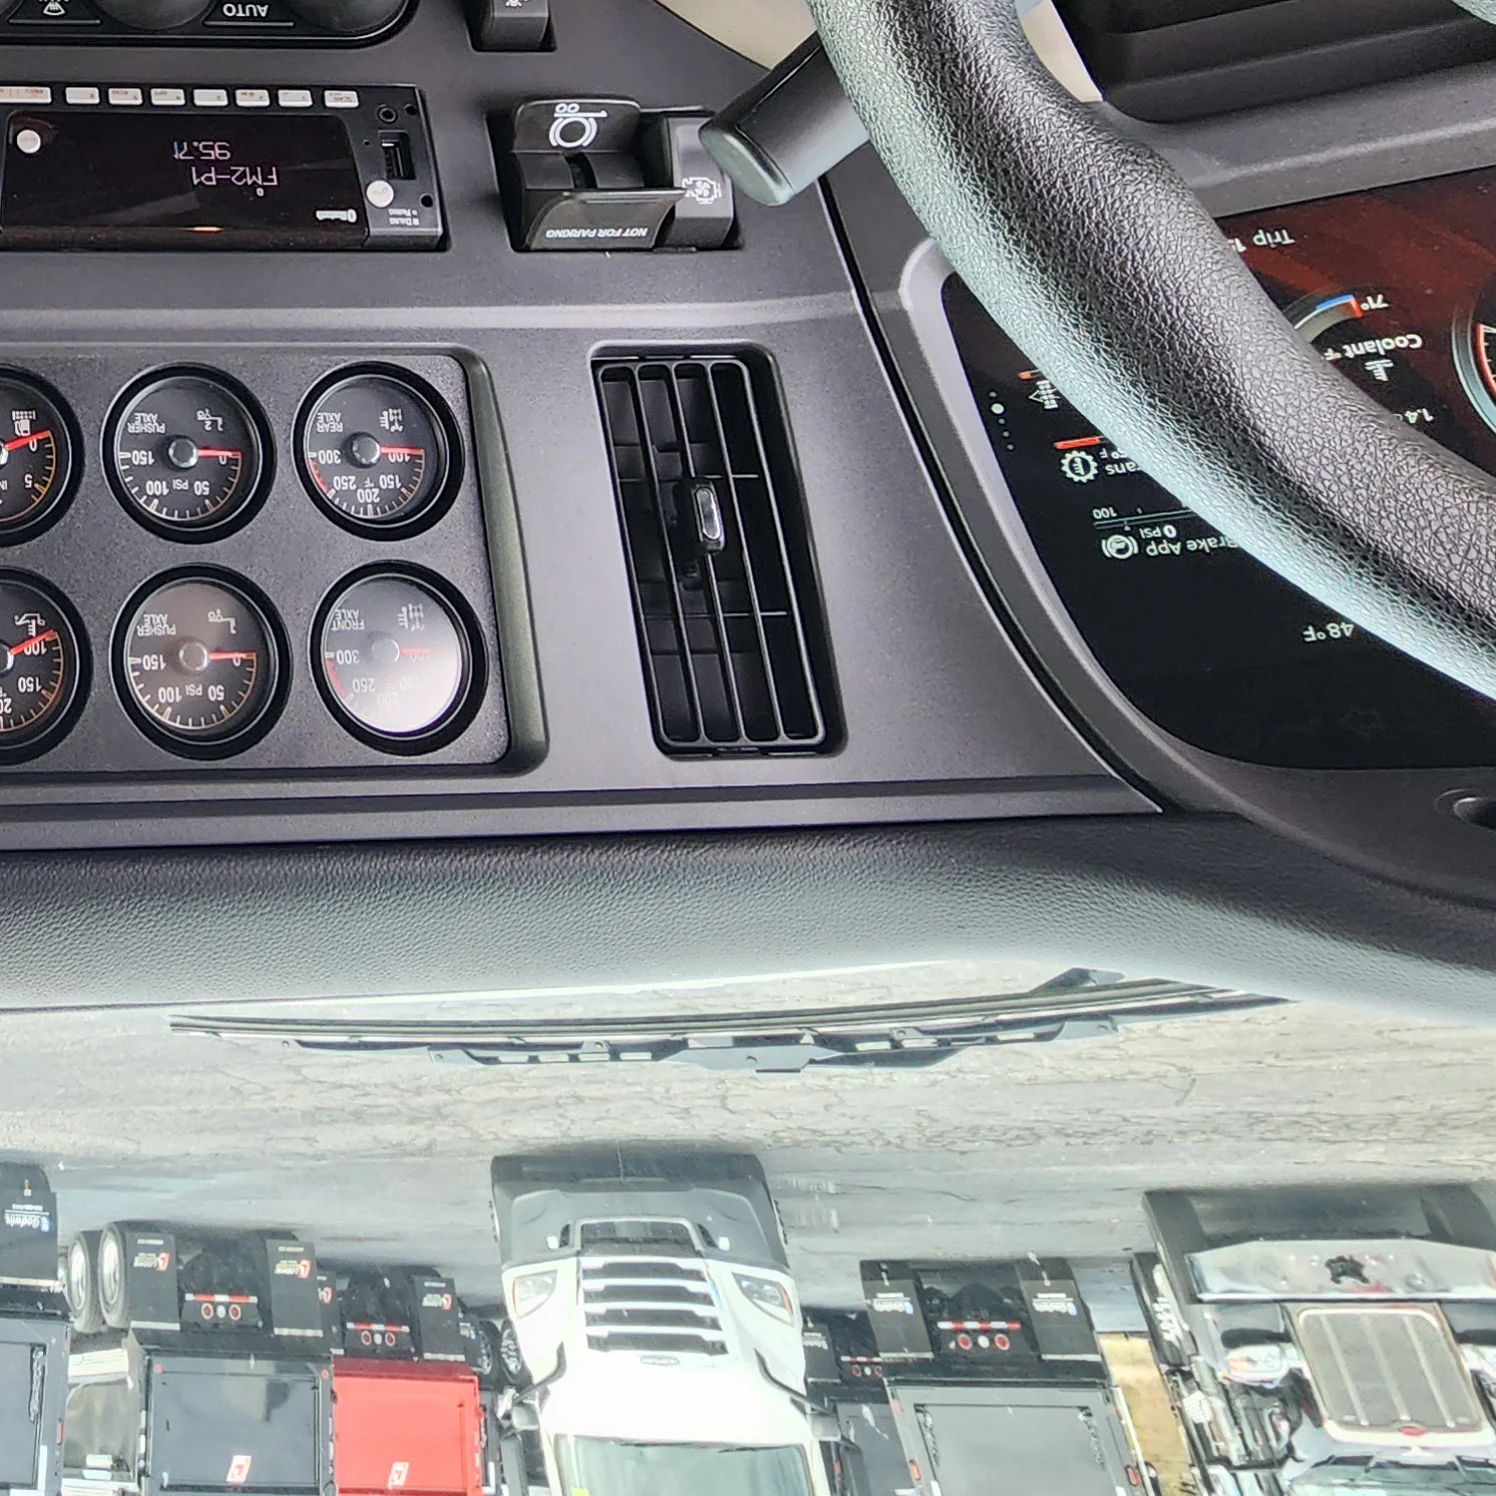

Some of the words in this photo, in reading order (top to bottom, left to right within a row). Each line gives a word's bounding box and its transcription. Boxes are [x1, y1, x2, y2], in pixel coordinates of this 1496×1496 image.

[222, 3, 269, 17] AUTO
[191, 166, 278, 186] FM2-P1
[546, 228, 597, 238] PARKING
[597, 227, 622, 237] FOR
[622, 227, 648, 237] NOT
[1253, 229, 1295, 247] Trip
[1343, 334, 1423, 358] Coolant
[134, 412, 159, 423] AXLE
[316, 412, 341, 423] AXLE
[127, 422, 165, 434] PUSHER
[316, 422, 343, 433] REAR
[131, 450, 155, 465] 150
[318, 449, 341, 464] 300
[24, 474, 33, 488] 5
[146, 480, 169, 496] 100
[172, 479, 189, 490] PSI
[194, 480, 210, 495] 50
[333, 476, 357, 490] 250
[379, 475, 402, 489] 150
[357, 488, 381, 503] 200
[1093, 506, 1117, 519] 100
[1139, 526, 1161, 538] PSI
[1164, 524, 1177, 539] 0
[1146, 538, 1182, 556] App
[143, 614, 168, 625] AXLE
[334, 609, 359, 620] AXLE
[136, 624, 176, 636] PUSHER
[331, 619, 365, 631] FRONT
[1302, 620, 1354, 642] 48°F
[142, 654, 166, 670] 150
[336, 649, 361, 664] 300
[17, 677, 42, 693] 150
[185, 684, 203, 696] PSI
[352, 678, 376, 692] 250
[158, 687, 182, 703] 100
[208, 685, 225, 701] 50
